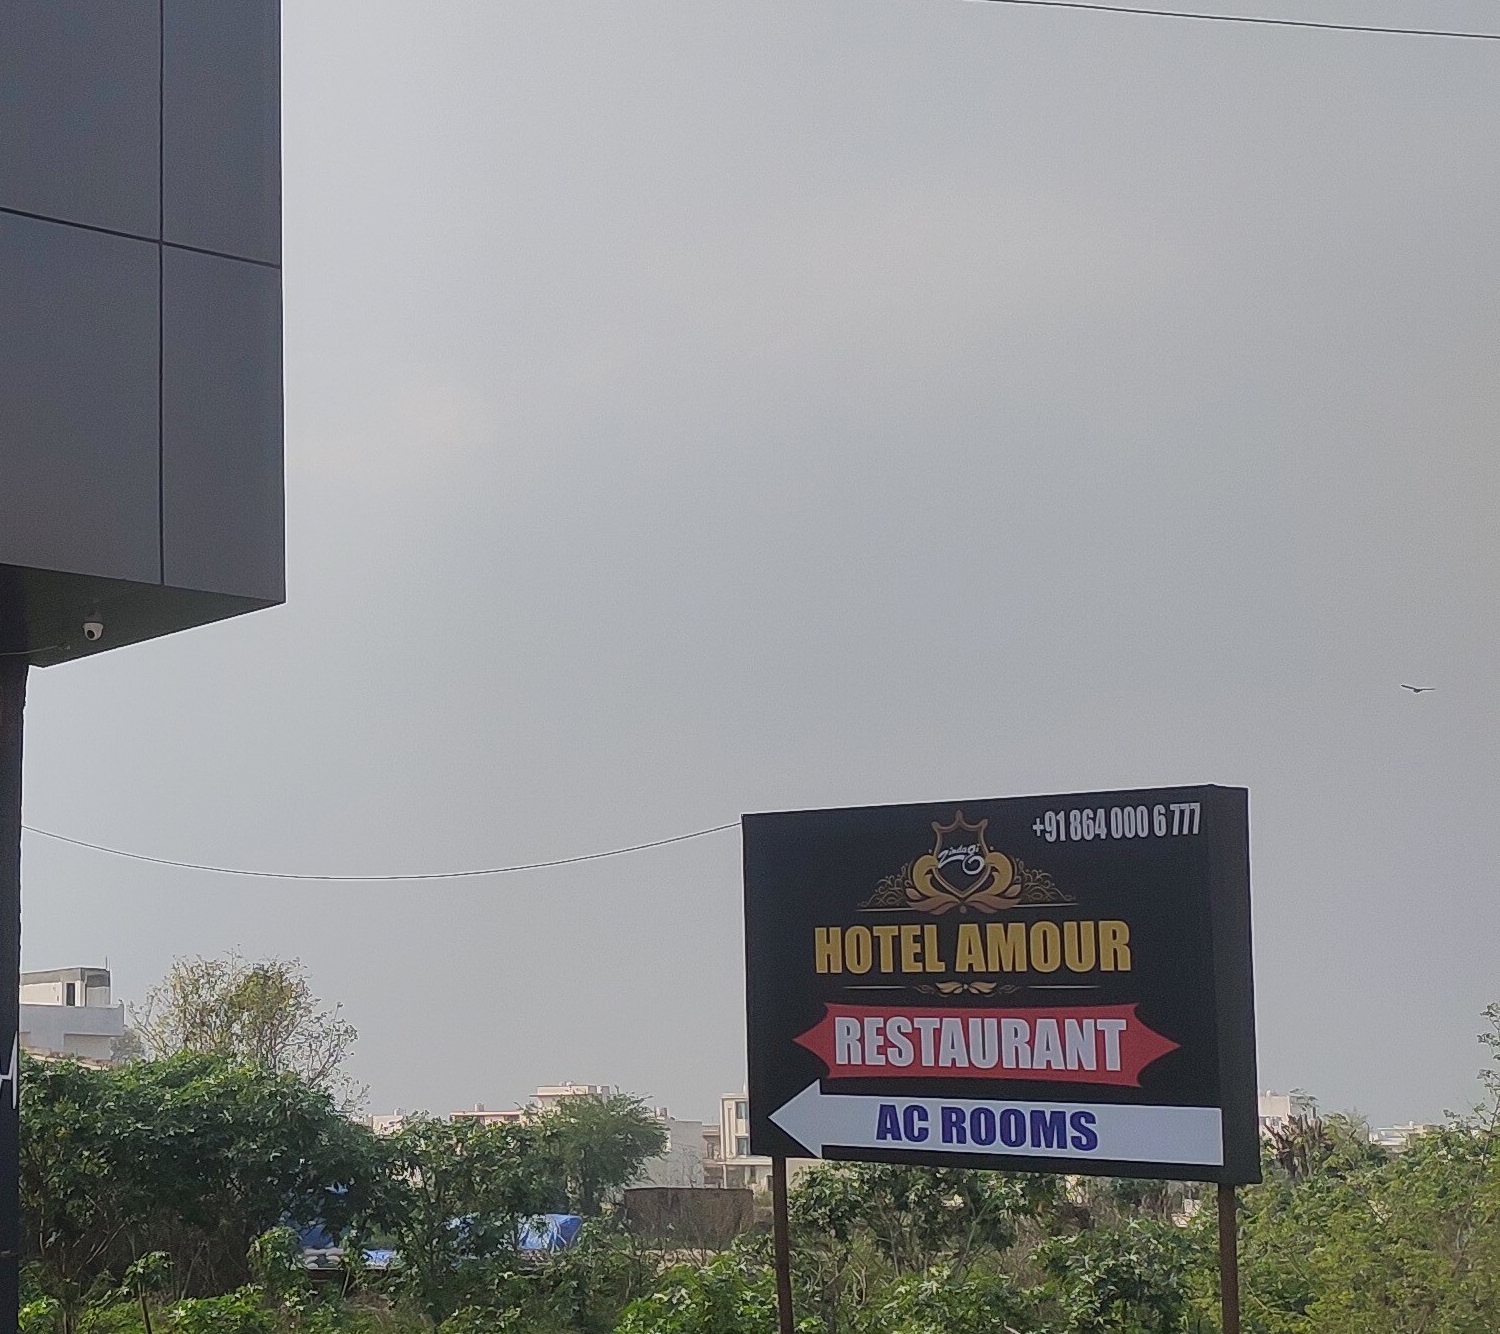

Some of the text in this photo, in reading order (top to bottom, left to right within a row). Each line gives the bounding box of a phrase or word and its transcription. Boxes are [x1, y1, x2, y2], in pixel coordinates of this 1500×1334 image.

[1032, 802, 1201, 842] +91 864 000 6 777
[814, 919, 1132, 974] HOTEL AMOUR
[834, 1016, 1127, 1072] RESTAURANT
[875, 1103, 1099, 1152] AC ROOMS
